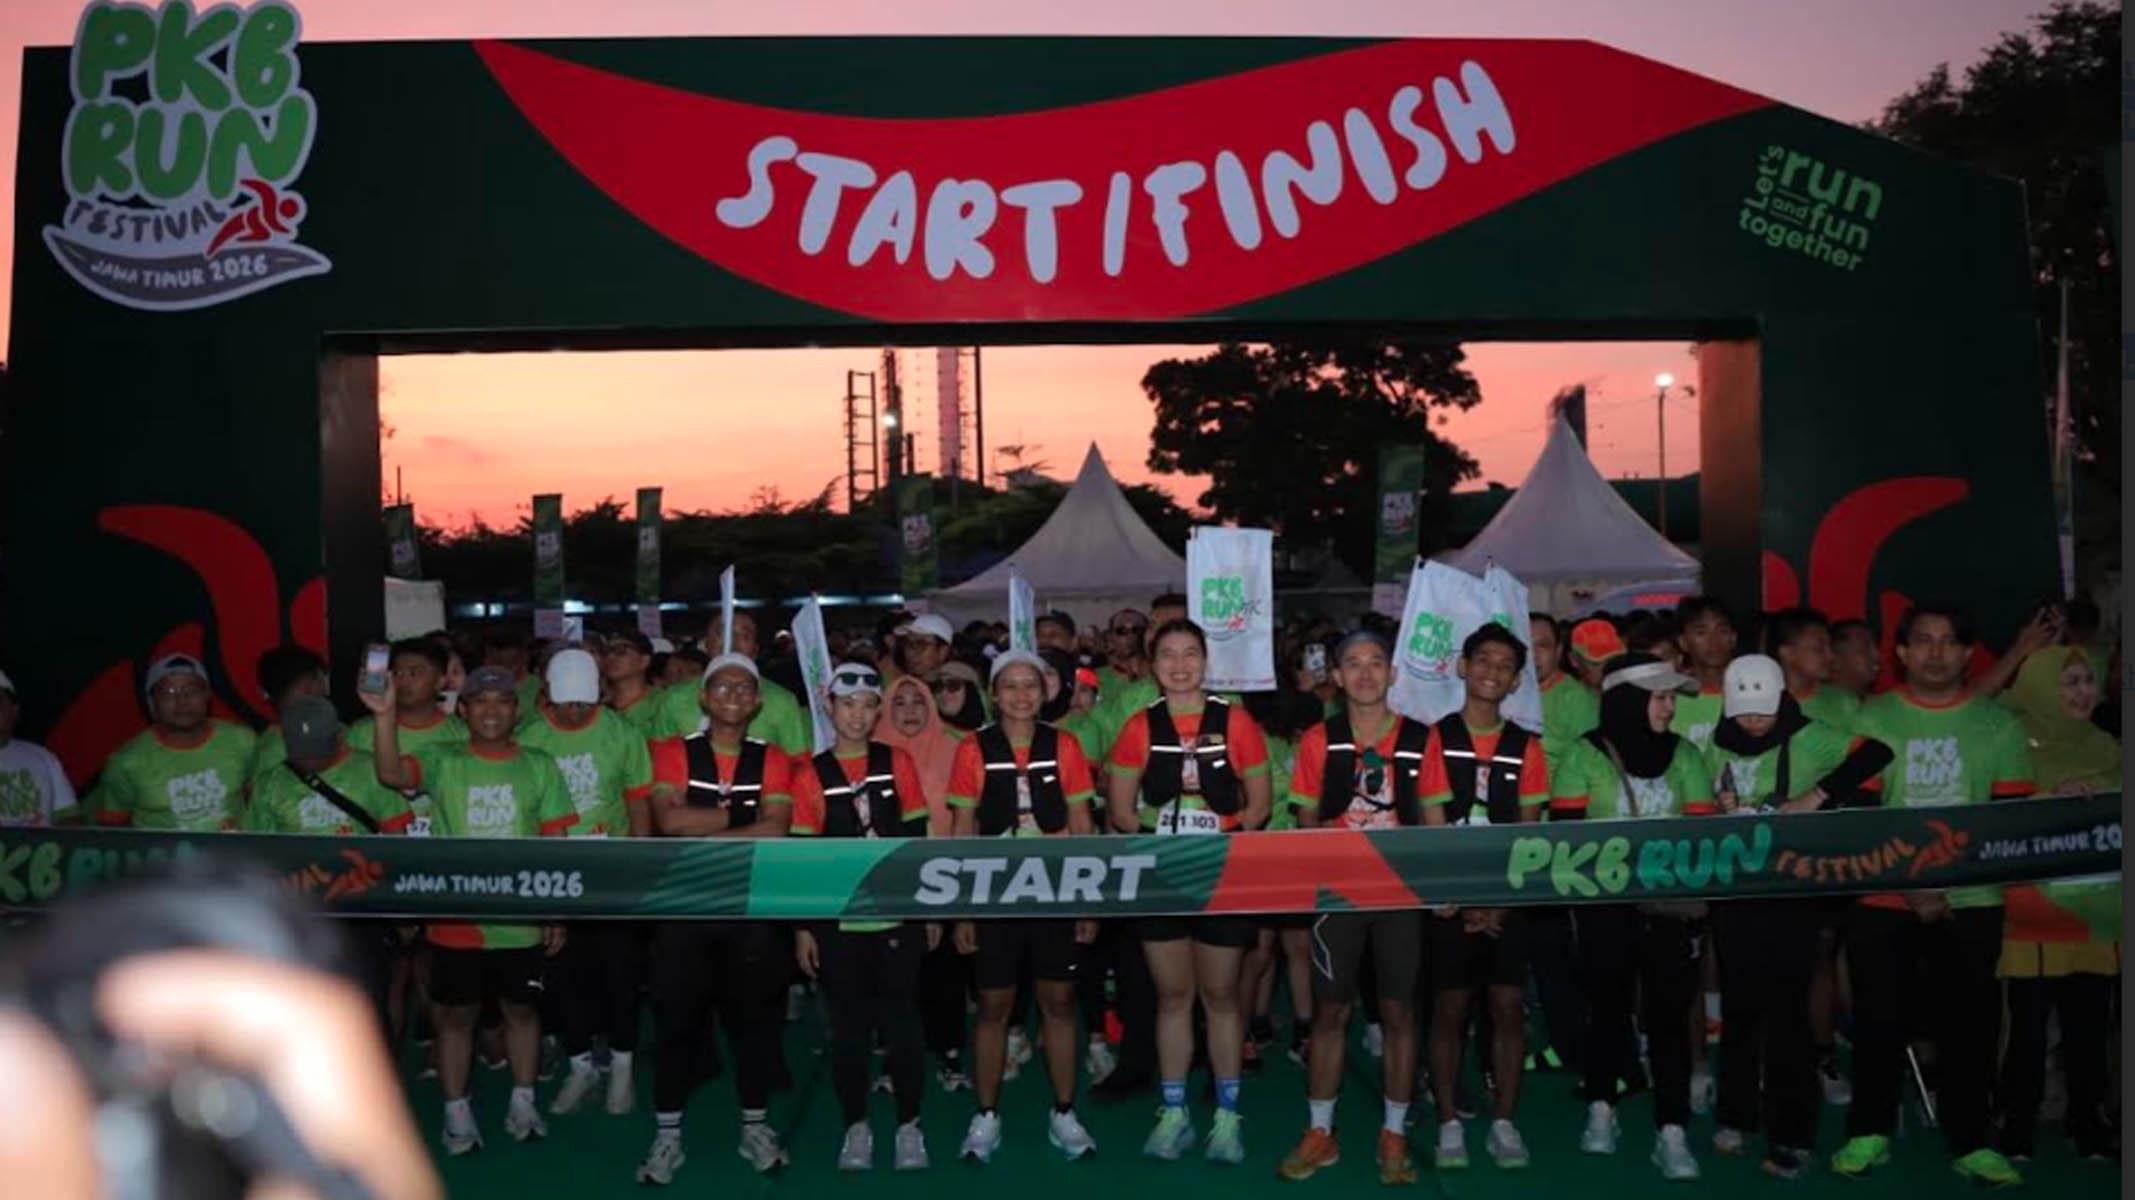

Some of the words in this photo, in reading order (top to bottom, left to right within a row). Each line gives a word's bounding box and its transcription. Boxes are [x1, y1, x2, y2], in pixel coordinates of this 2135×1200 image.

[76, 0, 296, 112] PKB
[69, 95, 309, 199] RUN
[1744, 145, 1785, 211] Let's
[1780, 150, 1883, 221] run
[69, 200, 227, 243] FESTIVAL
[1772, 197, 1809, 220] and
[1808, 203, 1869, 250] fun
[1739, 207, 1862, 271] together
[91, 260, 138, 283] JAWA
[142, 265, 205, 288] TIMUR
[209, 254, 268, 281] 2026
[394, 871, 448, 894] JAWA
[450, 873, 516, 896] TIMUR
[516, 869, 584, 899] 2026
[914, 854, 1157, 905] START
[1506, 836, 1631, 897] PKB
[1637, 822, 1772, 890] RUN
[1776, 837, 1917, 884] FESTIVAL
[1979, 837, 2028, 860] JAWA
[2031, 830, 2090, 855] TIMUR
